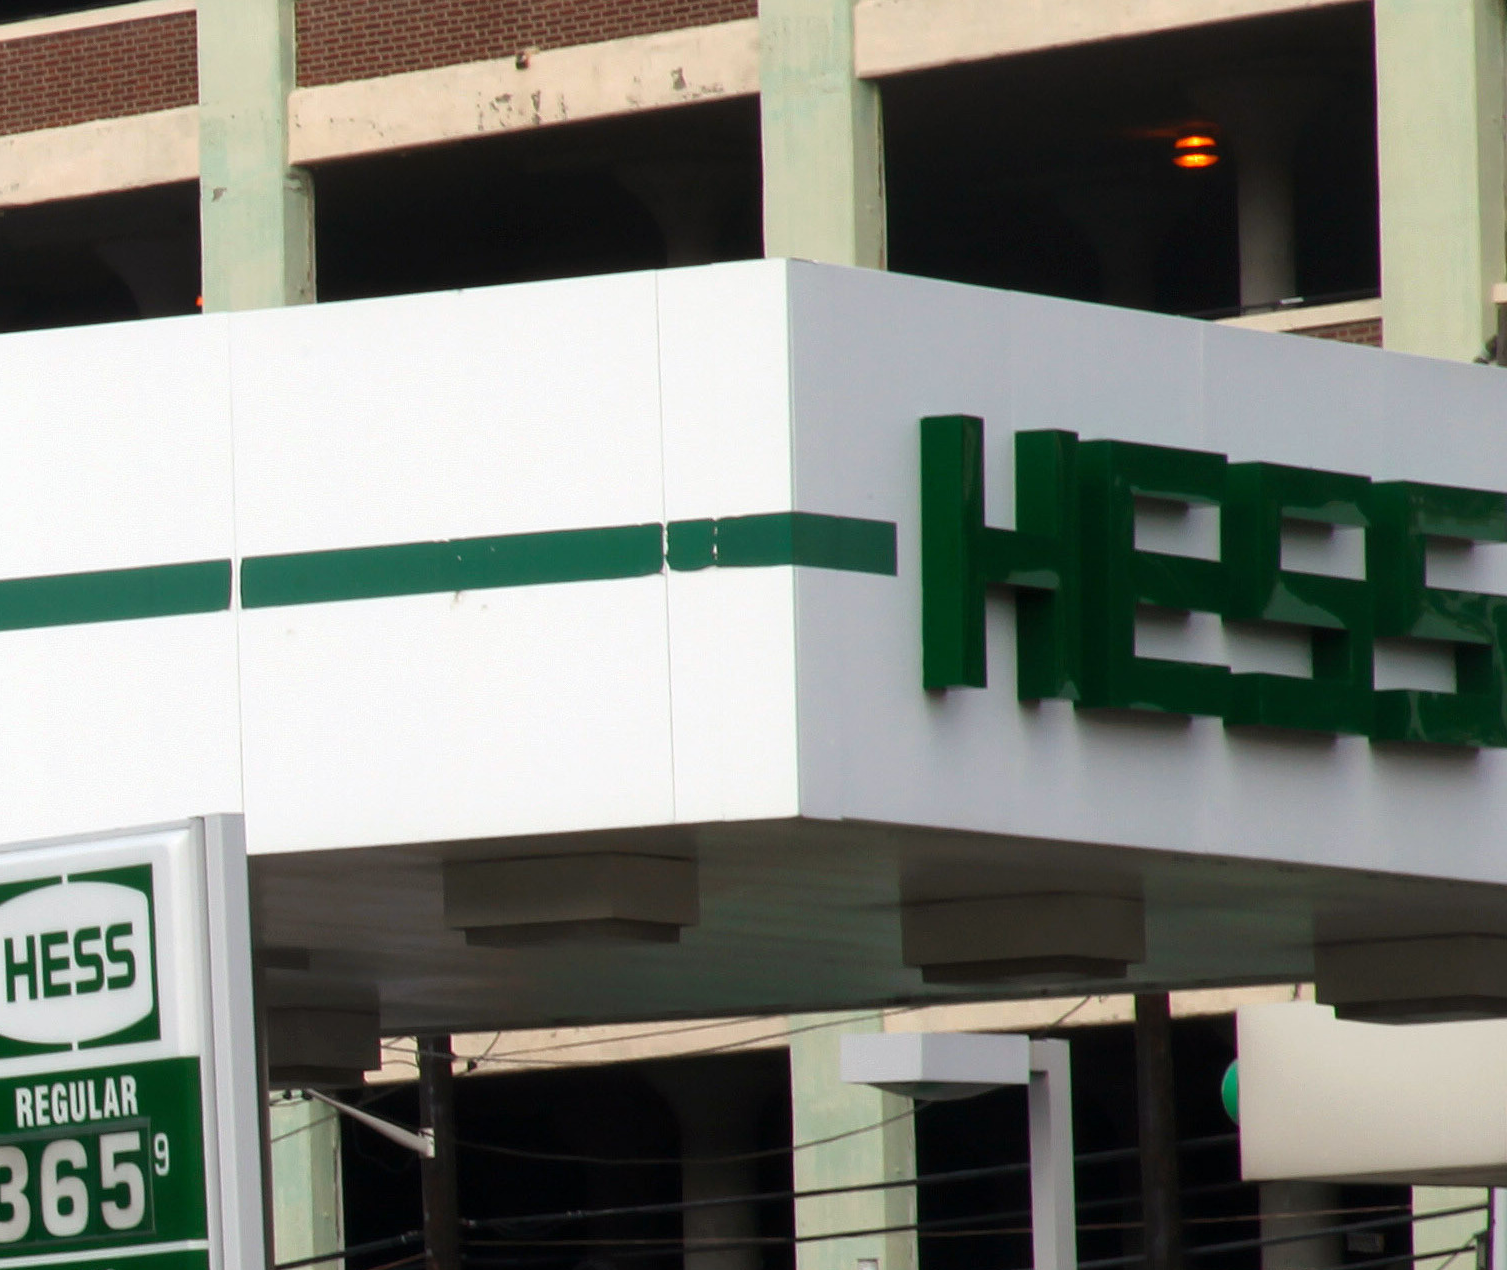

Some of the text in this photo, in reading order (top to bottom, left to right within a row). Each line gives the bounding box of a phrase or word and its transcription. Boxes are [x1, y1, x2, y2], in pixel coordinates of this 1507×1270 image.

[920, 414, 1507, 748] HESS
[4, 922, 136, 1003] HESS
[14, 1075, 139, 1129] REGULAR
[153, 1132, 170, 1177] 9
